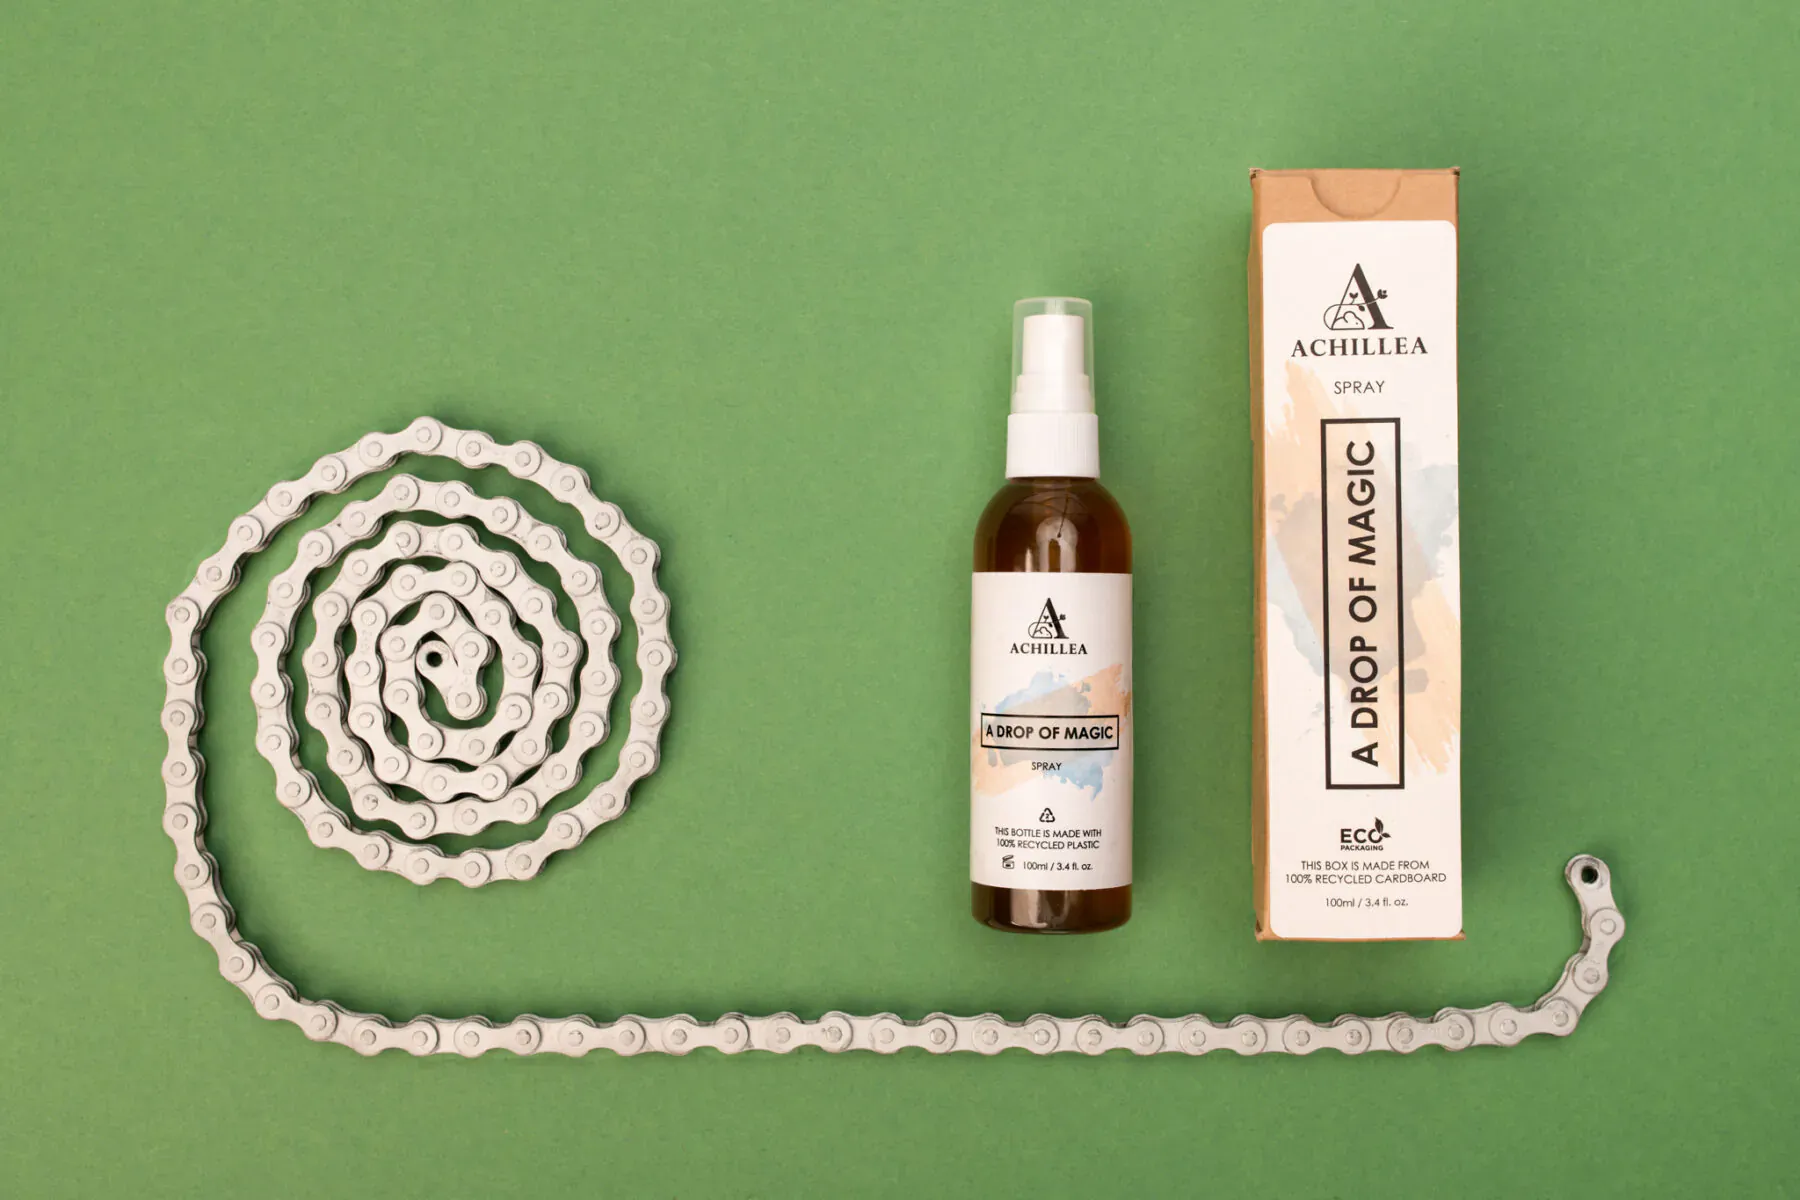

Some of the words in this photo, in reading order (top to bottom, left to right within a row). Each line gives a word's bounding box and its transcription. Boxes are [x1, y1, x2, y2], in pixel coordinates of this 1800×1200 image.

[1291, 337, 1428, 357] ACHILLEA
[1334, 381, 1384, 394] SPRAY
[1346, 441, 1376, 566] MAGIC
[1349, 578, 1377, 623] OF
[1010, 643, 1088, 655] ACHILLEA
[1350, 636, 1378, 728] DROP
[985, 725, 994, 739] A
[997, 725, 1033, 738] DROP
[1039, 727, 1059, 739] OF
[1064, 726, 1113, 740] MAGIC
[1352, 742, 1378, 767] A
[1032, 762, 1062, 770] SPRAY
[995, 827, 1009, 836] THIS
[1011, 828, 1041, 837] BOTTLE
[1053, 830, 1080, 838] MADE
[1083, 829, 1101, 837] WITH
[1341, 829, 1382, 843] ECO
[997, 839, 1015, 847] 100%
[1018, 840, 1065, 849] RECYCLED
[1067, 840, 1099, 849] PLASTIC
[1024, 862, 1048, 870] 100ml
[1050, 862, 1054, 871] /
[1301, 861, 1321, 870] THIS
[1325, 861, 1347, 870] BOX
[1352, 861, 1359, 871] IS
[1363, 861, 1394, 870] MADE
[1398, 861, 1429, 869] FROM
[1286, 874, 1312, 884] 100%
[1316, 874, 1372, 884] RECYCLED
[1375, 873, 1446, 883] CARDBOARD
[1326, 898, 1355, 907] 100ml
[1358, 898, 1362, 908] /
[1366, 898, 1379, 907] 3.4
[1383, 898, 1391, 906] fl.
